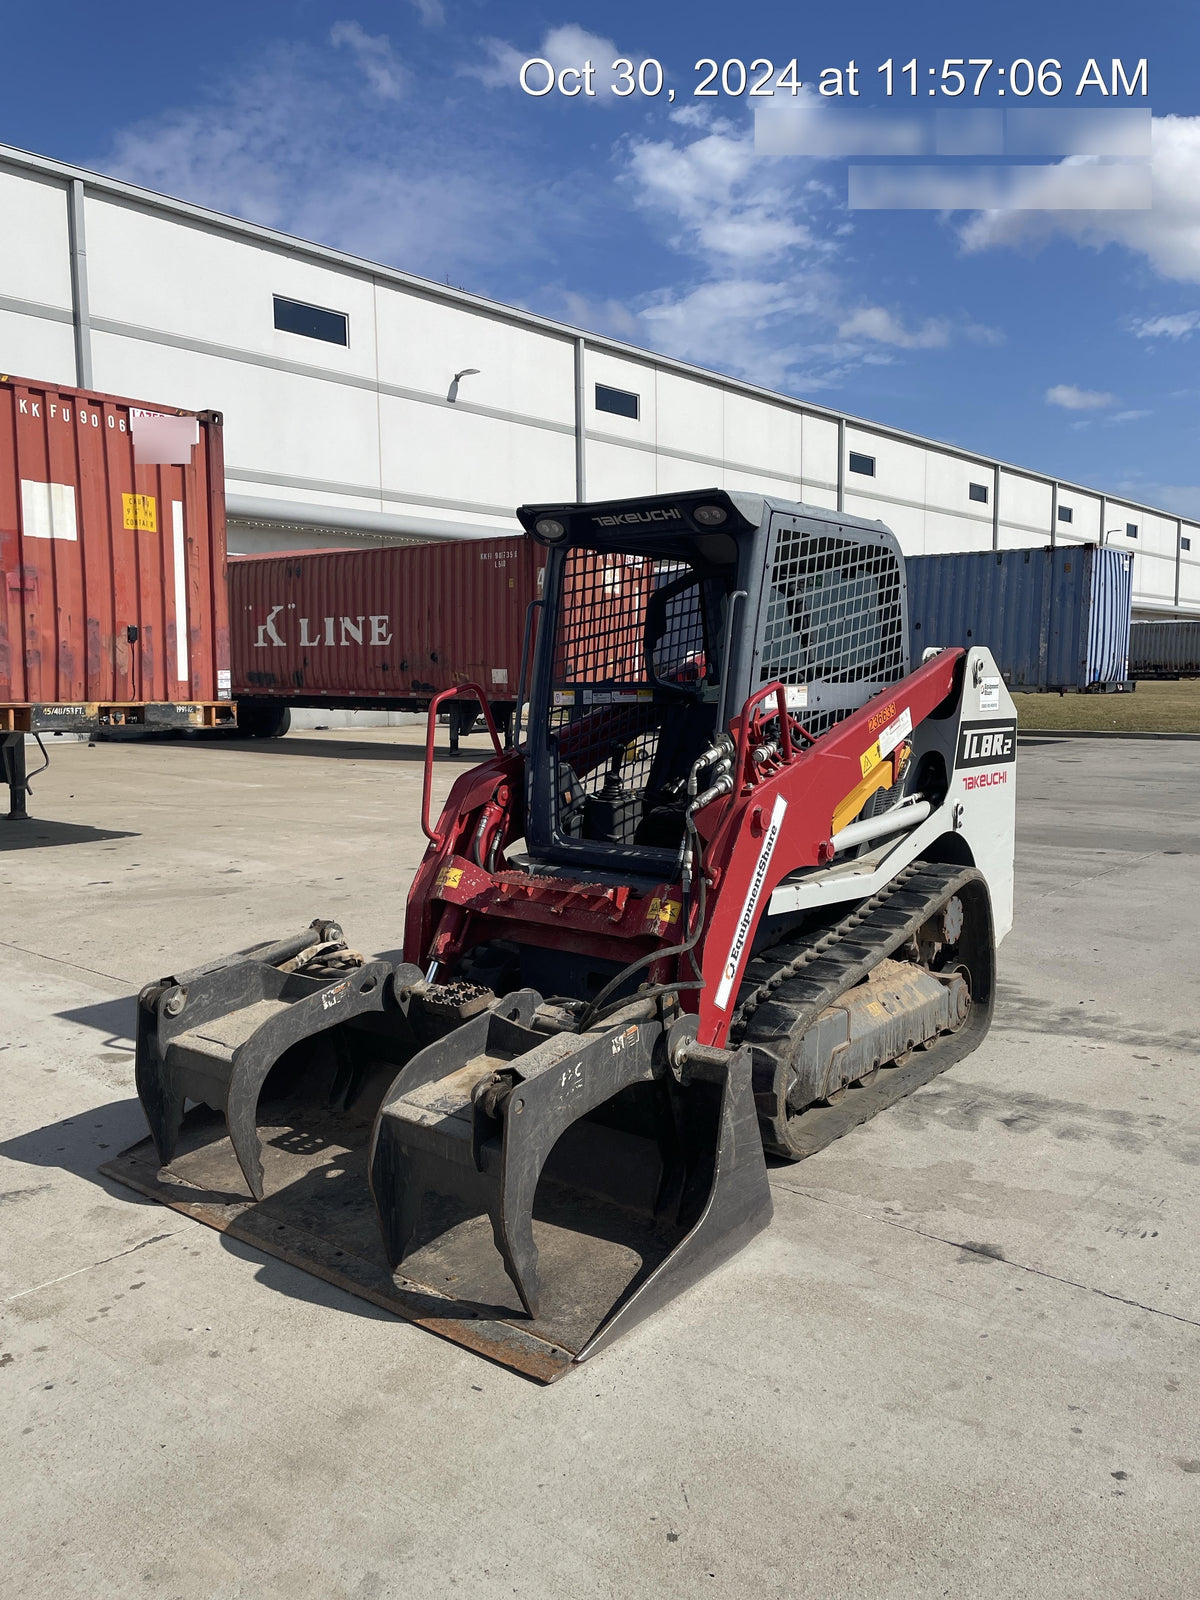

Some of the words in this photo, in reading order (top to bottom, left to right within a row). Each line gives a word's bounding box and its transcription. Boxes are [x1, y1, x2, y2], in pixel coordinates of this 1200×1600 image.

[592, 508, 682, 526] TAKEUCHI
[299, 615, 393, 646] LINE
[868, 703, 896, 732] 236633
[962, 771, 1007, 790] TAKEUCHI
[730, 824, 778, 962] EquipmentShare
